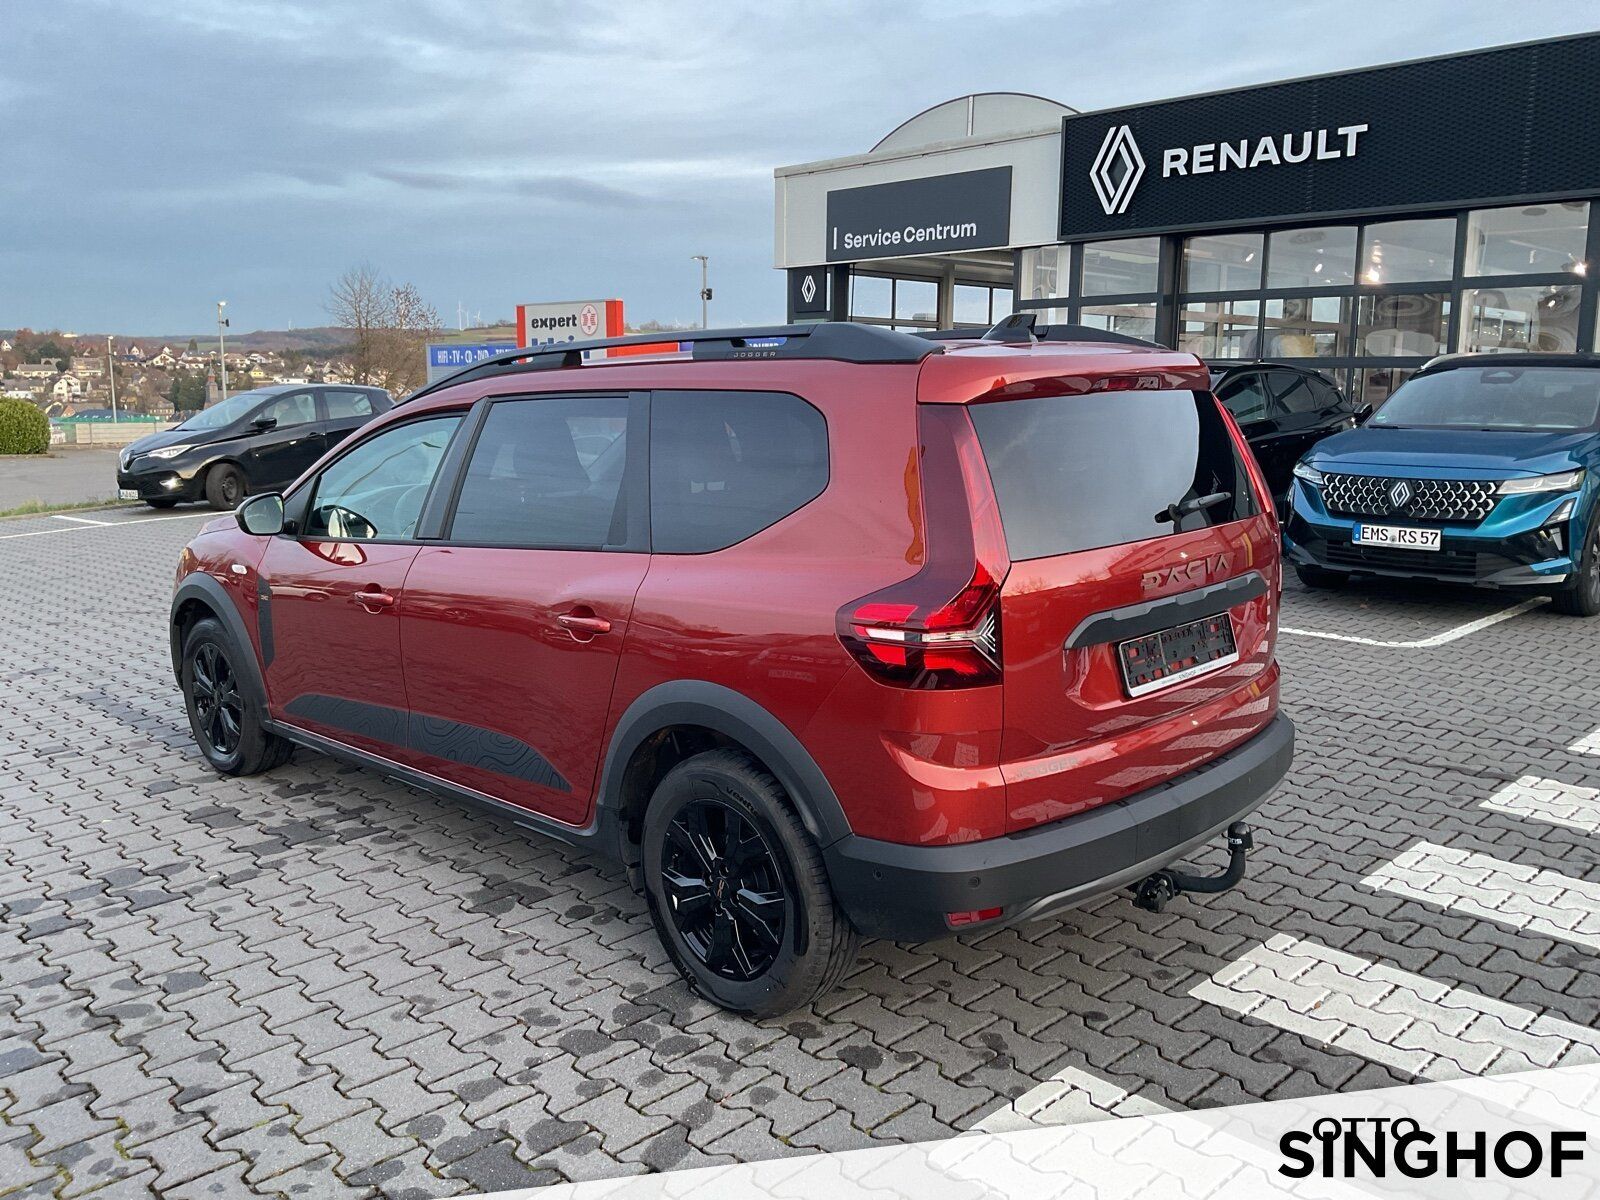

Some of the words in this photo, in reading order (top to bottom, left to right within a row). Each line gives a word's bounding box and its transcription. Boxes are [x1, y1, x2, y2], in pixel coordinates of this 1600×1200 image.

[1162, 124, 1368, 178] RENAULT
[844, 229, 900, 249] Service
[903, 222, 977, 243] Centrum
[531, 314, 577, 330] expert
[1361, 526, 1389, 541] EMS
[1398, 529, 1417, 544] RS
[1420, 531, 1439, 545] 57
[1141, 554, 1230, 591] DACIA
